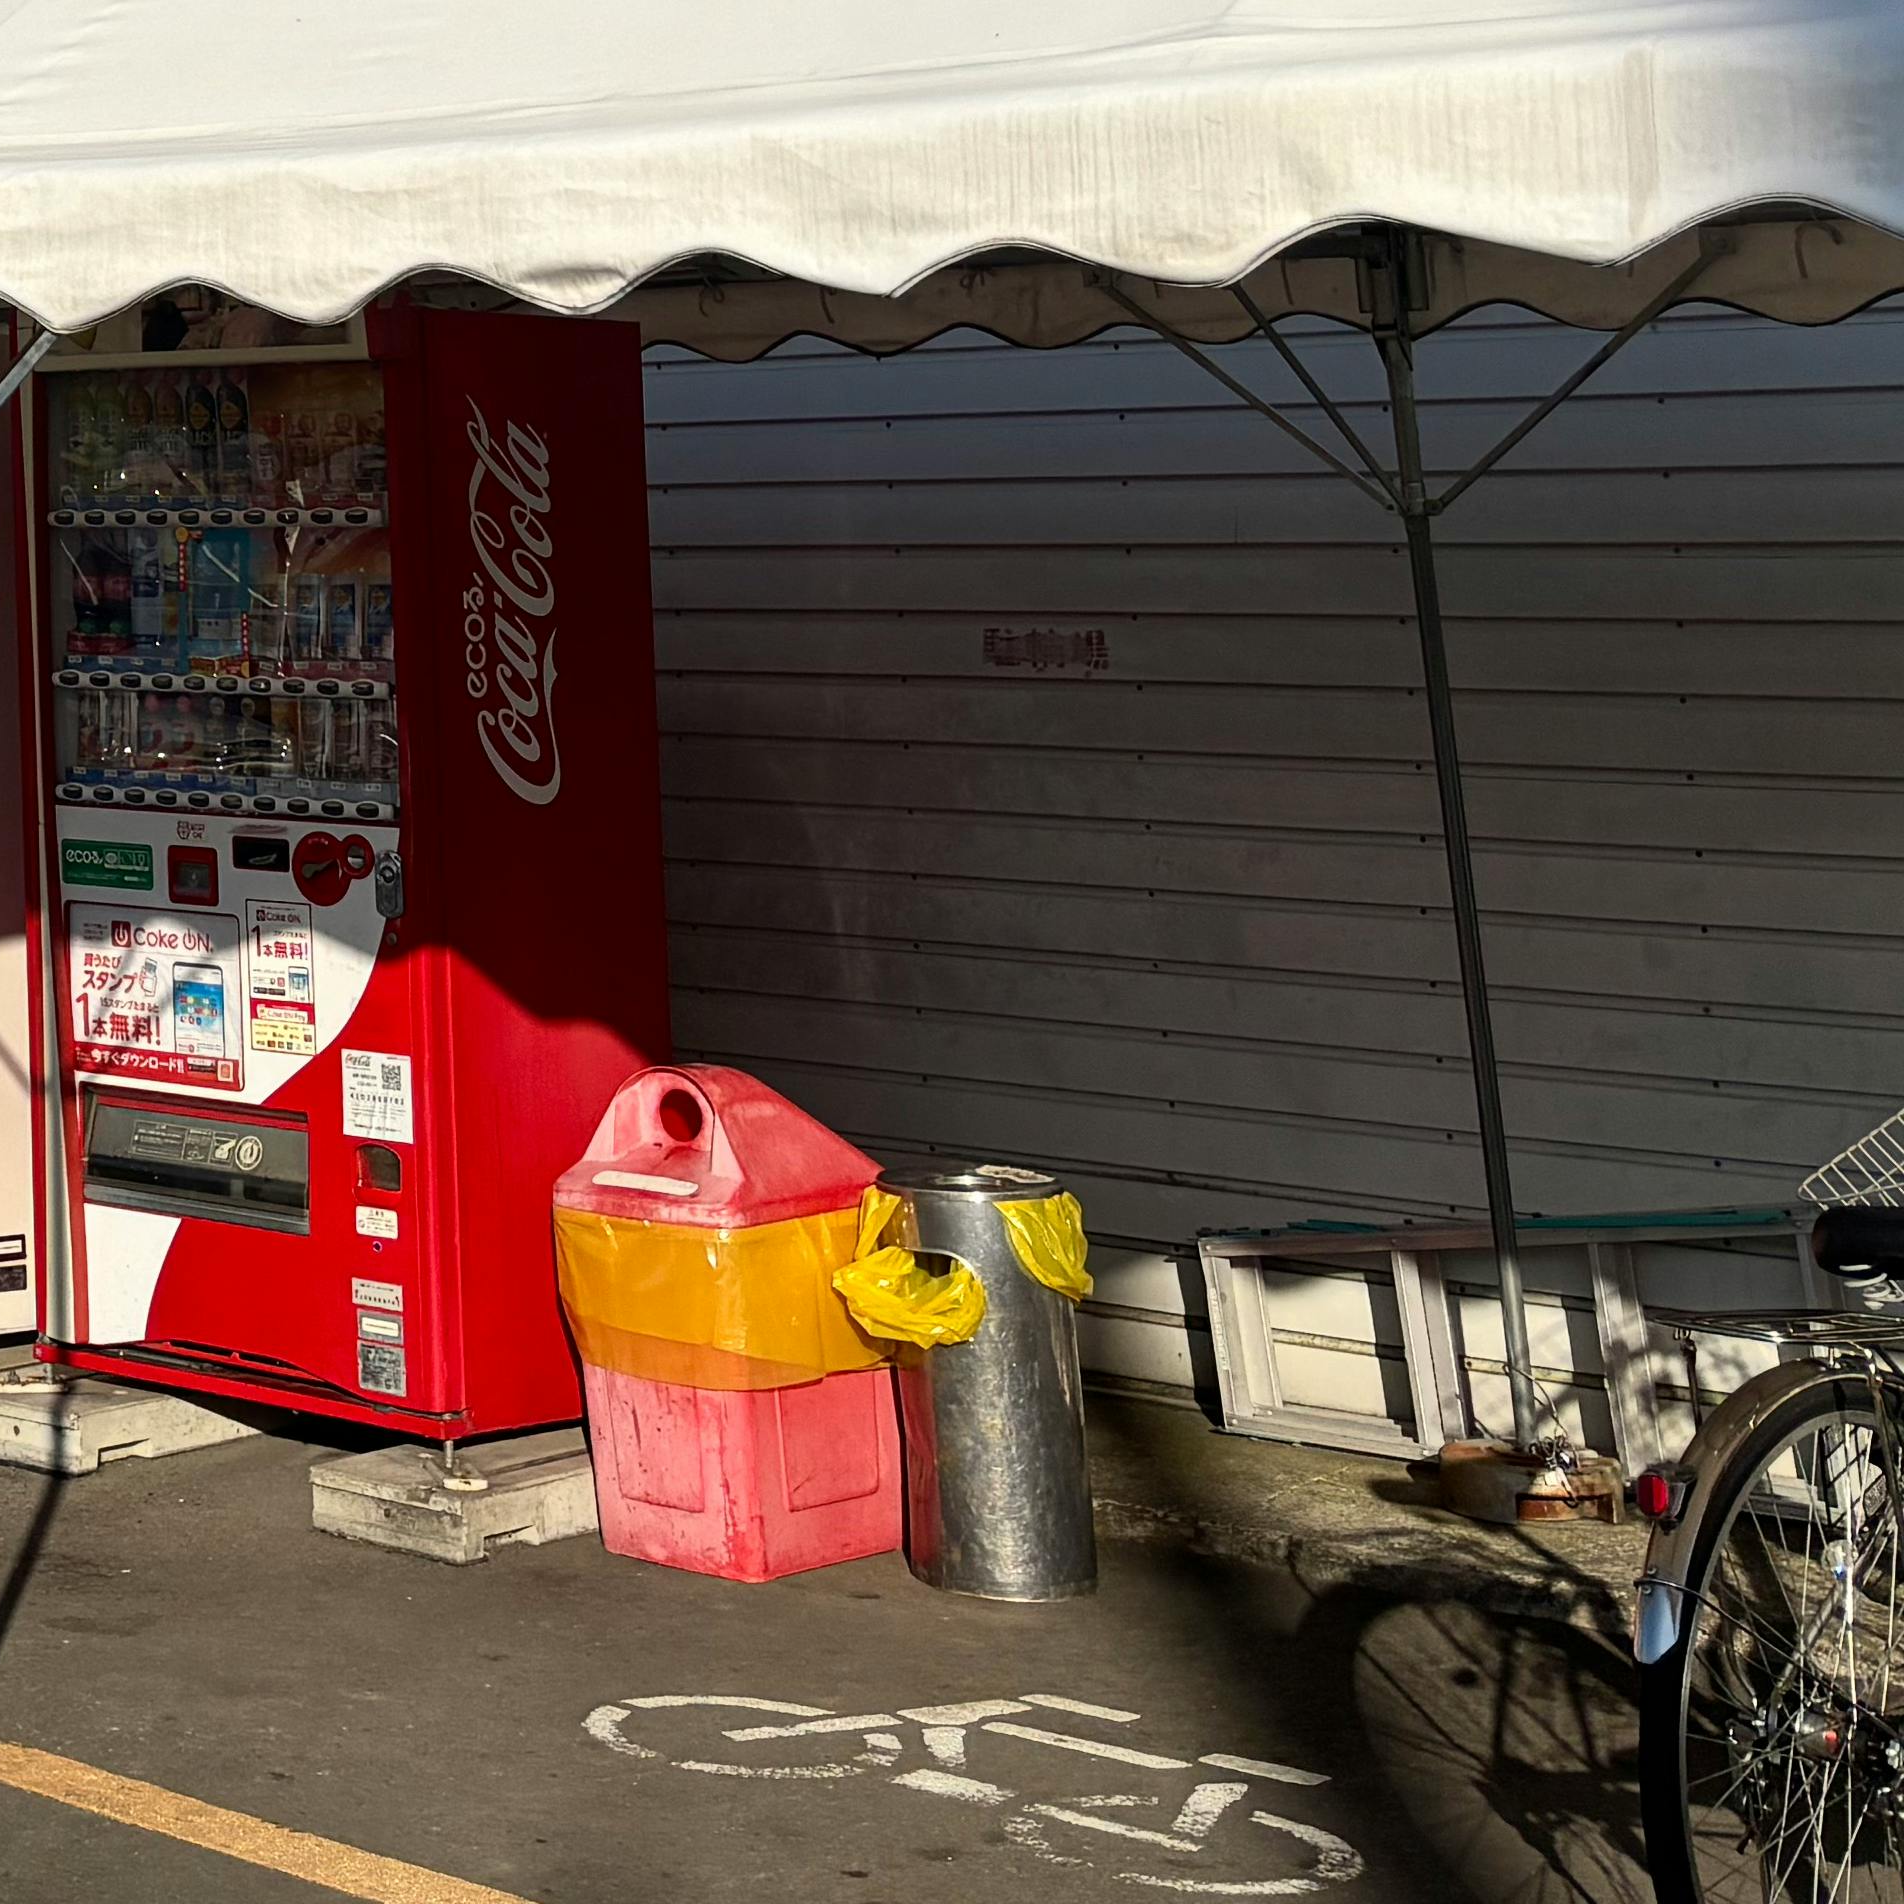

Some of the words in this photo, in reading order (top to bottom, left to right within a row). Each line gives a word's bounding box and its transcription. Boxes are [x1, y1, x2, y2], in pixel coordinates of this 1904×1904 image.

[466, 394, 561, 805] Coca-Cola
[133, 927, 178, 949] Coke
[84, 953, 122, 969] 買うたび
[82, 970, 138, 993] スタンプ
